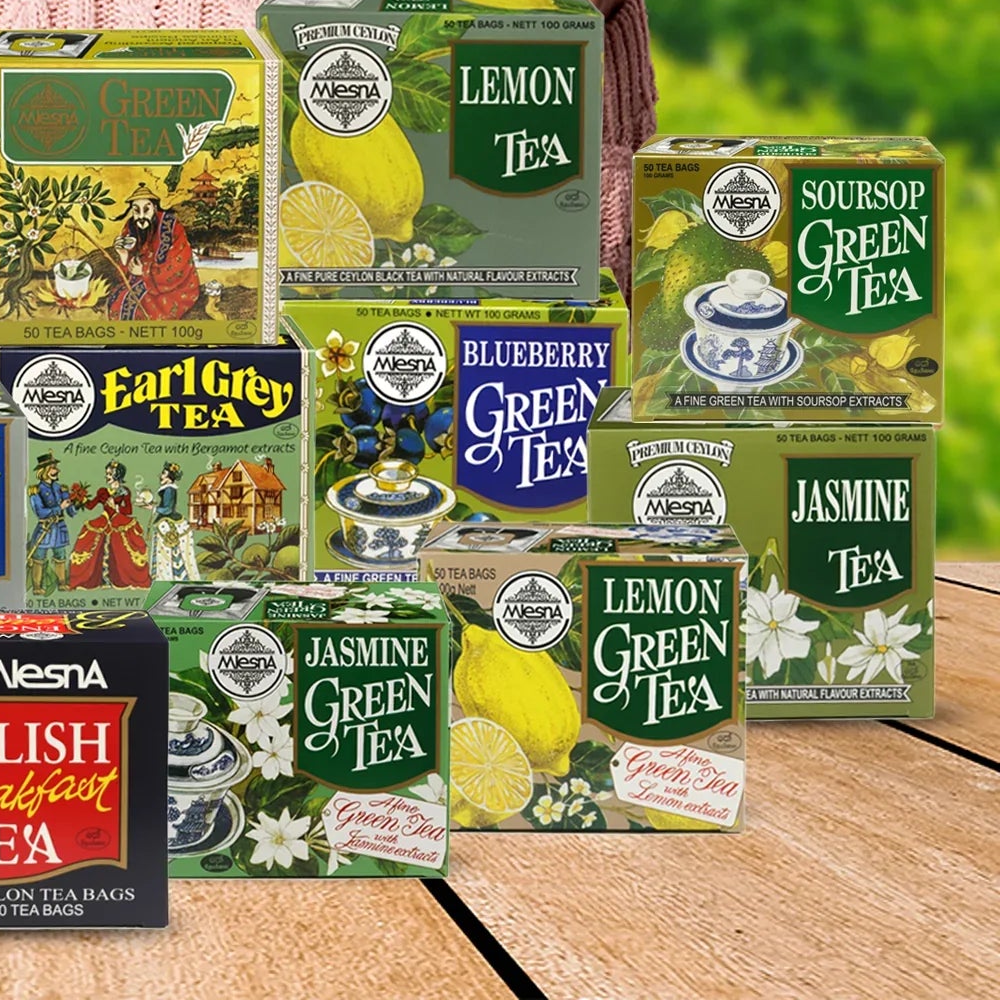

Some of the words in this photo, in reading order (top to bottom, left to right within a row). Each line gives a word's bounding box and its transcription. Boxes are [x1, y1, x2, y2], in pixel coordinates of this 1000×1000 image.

[298, 25, 350, 44] PREMIUM
[352, 26, 396, 45] CEYLON
[100, 77, 221, 118] GREEN
[460, 66, 576, 104] LEMON
[100, 118, 176, 157] TEA
[494, 130, 571, 178] TEA
[644, 164, 654, 172] 50
[656, 164, 673, 172] TEA
[675, 164, 700, 172] BAGS
[801, 180, 925, 210] SOURSOP
[797, 214, 928, 301] GREEN
[837, 265, 923, 316] TEA
[24, 327, 39, 338] 50
[43, 327, 73, 338] TEA
[75, 327, 116, 338] BAGS
[129, 326, 166, 337] NETT
[172, 326, 203, 340] 100g
[357, 309, 368, 317] 50
[370, 309, 391, 317] TEA
[393, 309, 421, 317] BAGS
[436, 309, 461, 318] NETT
[466, 310, 482, 318] WT
[485, 311, 501, 319] 100
[504, 311, 540, 320] GRAMS
[463, 340, 610, 369] BLUEBERRY
[101, 356, 196, 415] Earl
[201, 359, 294, 419] Grey
[675, 396, 682, 406] A
[685, 396, 706, 406] FINE
[709, 396, 744, 406] GREEN
[747, 396, 766, 406] TEA
[767, 396, 794, 406] WITH
[796, 396, 846, 407] SOURSOP
[849, 396, 902, 407] EXTRACTS
[150, 403, 245, 429] TEA
[464, 377, 608, 472] GREEN
[64, 443, 73, 454] A
[75, 443, 93, 455] fine
[100, 443, 138, 456] Ceylon
[167, 443, 189, 454] with
[191, 442, 249, 456] Bergamot
[251, 443, 296, 453] extracts
[632, 440, 683, 461] PREMIUM
[685, 441, 730, 460] CEYLON
[777, 434, 788, 442] 50
[790, 434, 807, 442] TEA
[810, 434, 836, 442] BAGS
[845, 434, 869, 442] NETT
[873, 434, 891, 442] 100
[895, 434, 926, 442] GRAMS
[507, 433, 587, 489] TEA
[792, 479, 910, 523] JASMINE
[828, 545, 903, 595] TEA
[603, 578, 722, 613] LEMON
[305, 637, 428, 667] JASMINE
[593, 619, 729, 710] GREEN
[635, 672, 723, 727] TEA
[755, 688, 778, 699] WITH
[781, 688, 818, 699] NATURAL
[820, 688, 857, 699] FLAVOUR
[860, 688, 903, 699] EXTRACTS
[304, 672, 433, 757] GREEN
[344, 722, 427, 772] TEA
[623, 751, 691, 782] Green
[692, 768, 739, 796] Tea
[333, 799, 400, 831] Green
[400, 814, 445, 840] Tea
[11, 905, 40, 917] TEA
[43, 904, 83, 917] BAGS
[40, 888, 80, 901] TEA
[83, 888, 135, 900] BAGS
